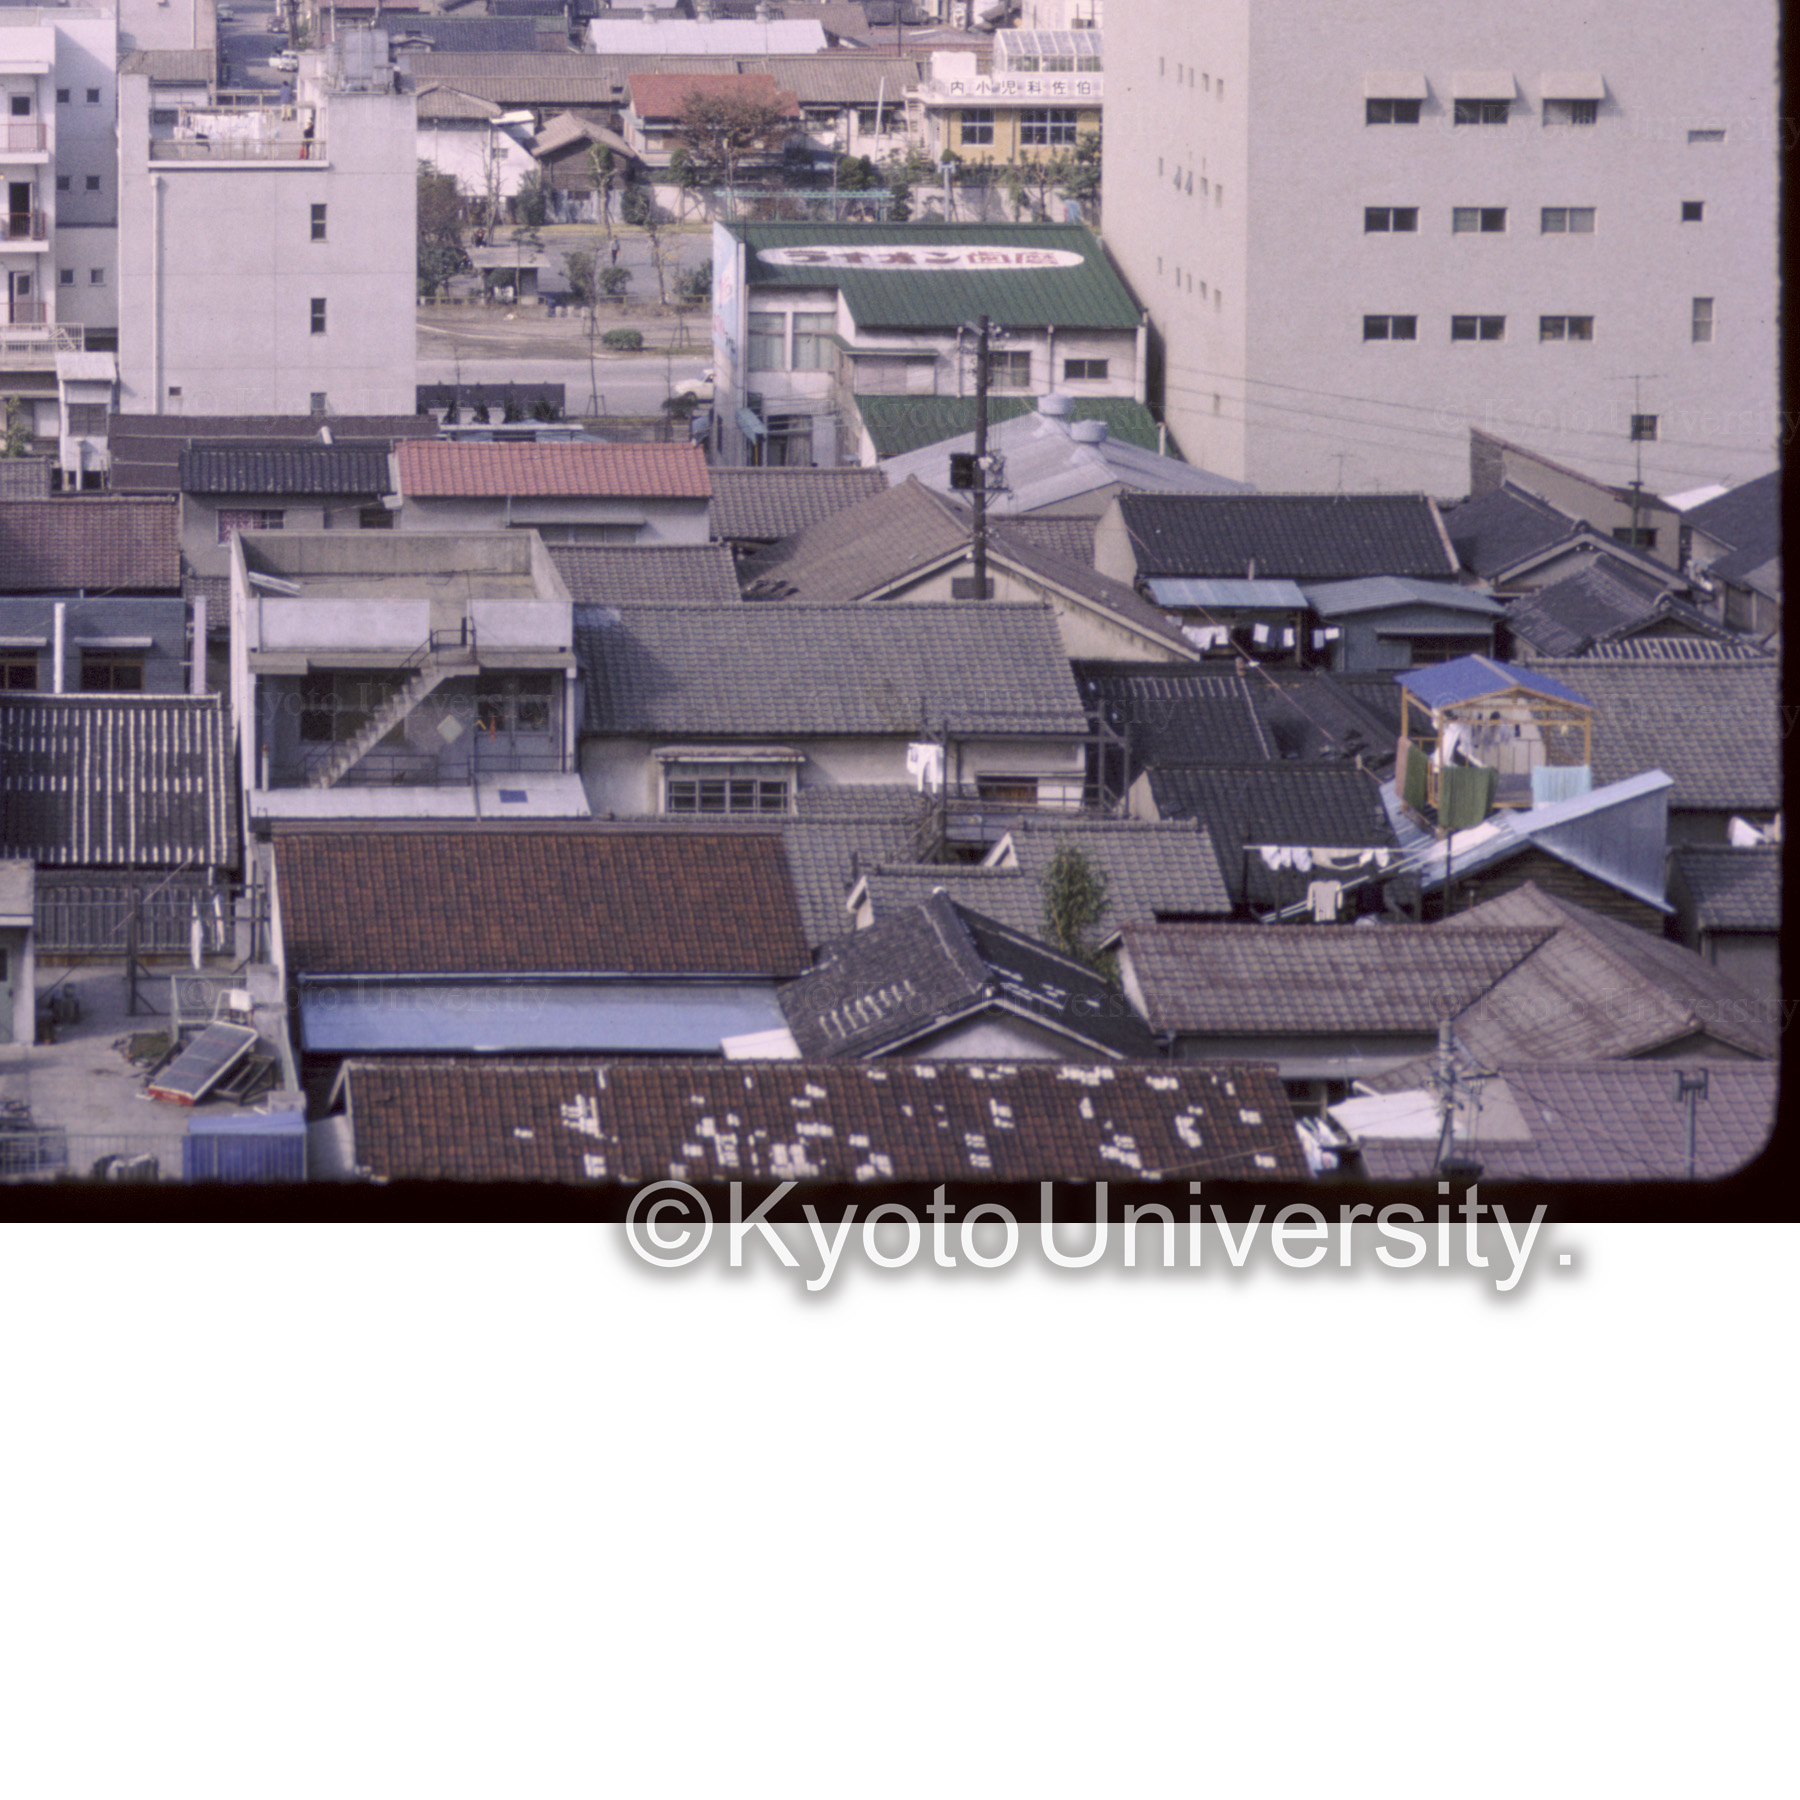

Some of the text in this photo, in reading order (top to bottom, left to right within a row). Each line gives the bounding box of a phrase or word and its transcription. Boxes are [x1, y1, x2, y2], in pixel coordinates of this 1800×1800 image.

[949, 80, 1092, 96] 内小児科佐伯
